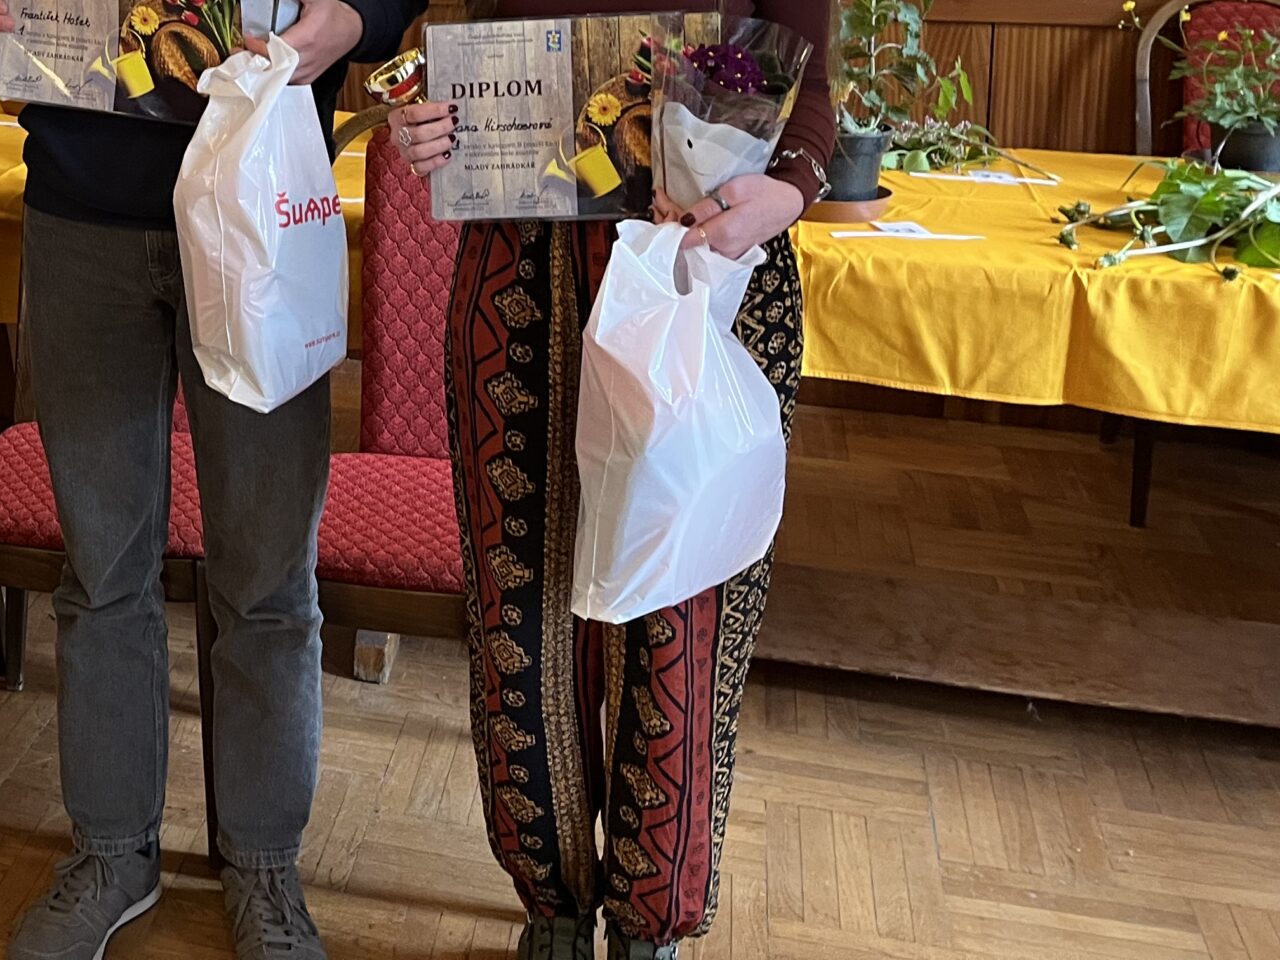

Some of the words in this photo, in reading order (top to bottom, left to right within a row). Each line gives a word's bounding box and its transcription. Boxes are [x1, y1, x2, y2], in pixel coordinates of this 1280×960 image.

[451, 79, 542, 99] DIPLOM
[455, 124, 479, 133] ana
[275, 192, 341, 228] Šumpe
